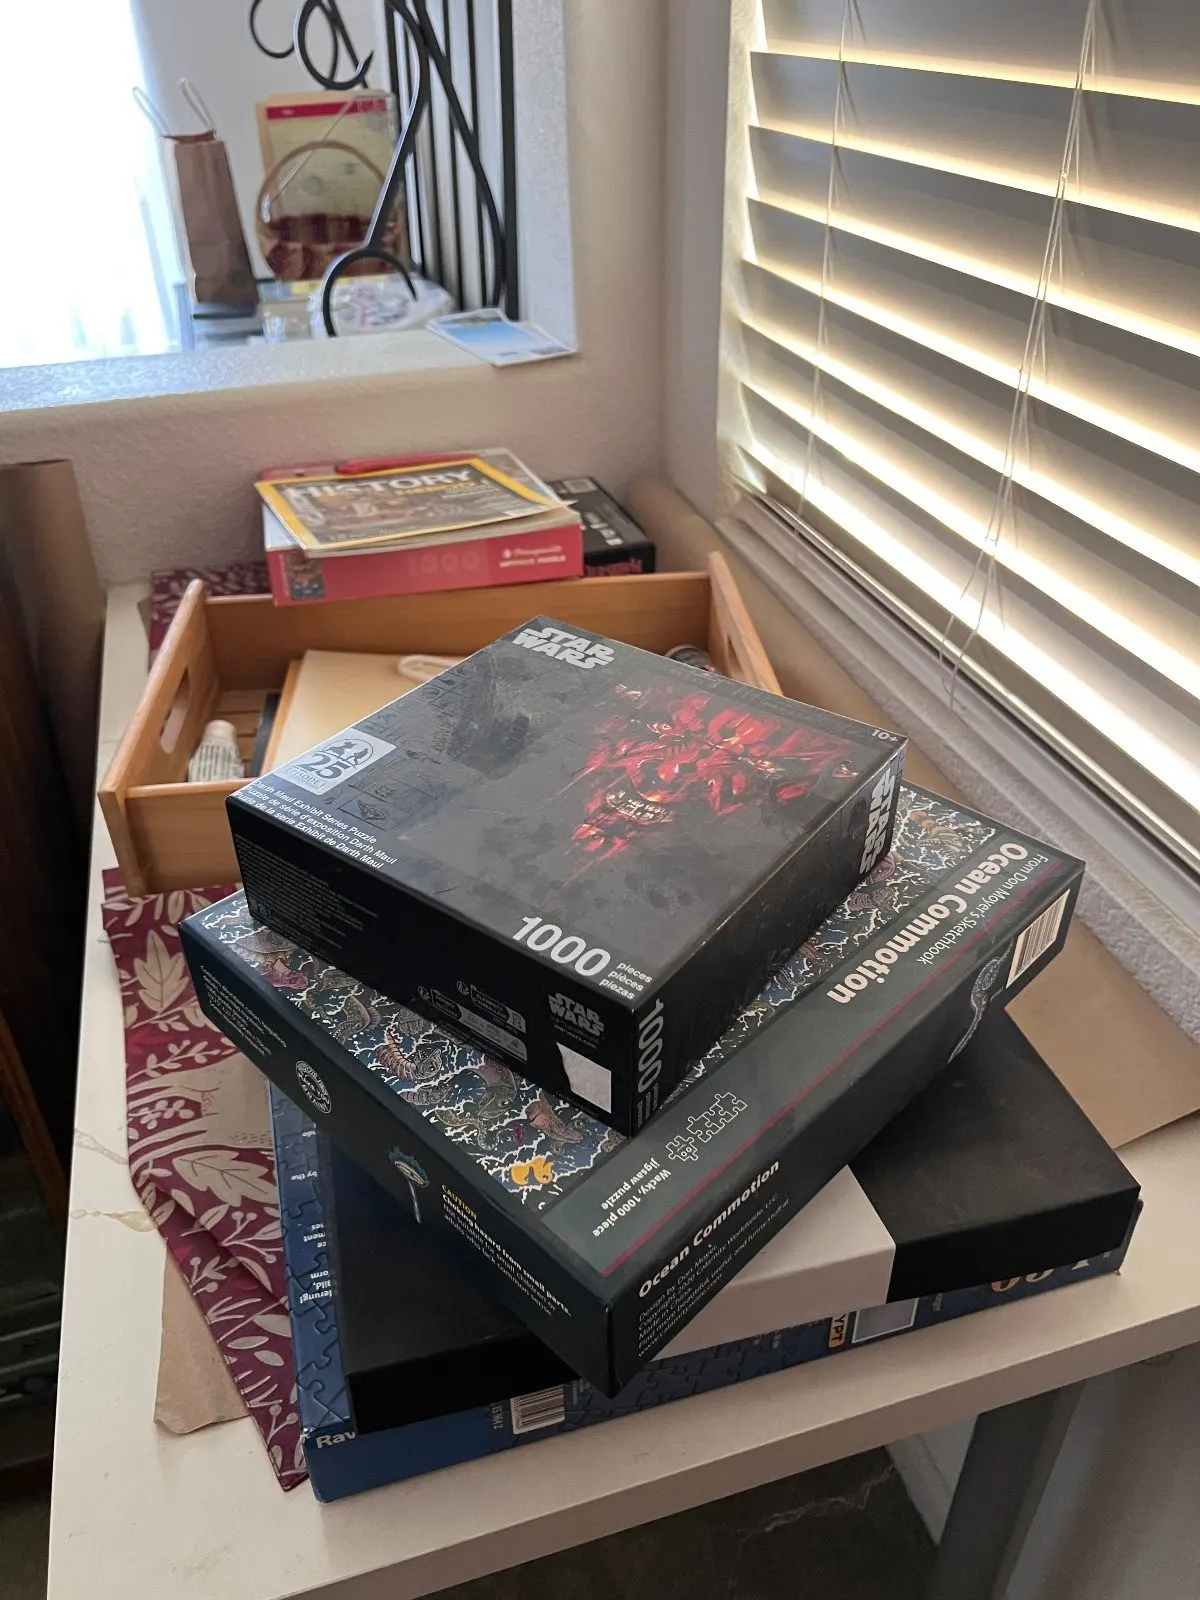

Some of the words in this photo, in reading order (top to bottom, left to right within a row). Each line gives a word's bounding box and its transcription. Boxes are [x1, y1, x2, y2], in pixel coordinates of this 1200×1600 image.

[512, 632, 610, 669] WARS
[522, 627, 615, 662] STAR
[869, 728, 899, 743] 10+
[294, 752, 352, 780] 25
[246, 786, 269, 801] Puzzle
[268, 798, 280, 806] de
[299, 813, 350, 842] d'exposition
[349, 838, 374, 853] Darth
[373, 849, 398, 865] Maul
[252, 779, 275, 793] Darth
[273, 790, 296, 803] Maul
[293, 799, 324, 817] Exhibit
[321, 813, 349, 830] Series
[347, 826, 377, 844] Puzzle
[859, 773, 886, 874] WARS
[865, 767, 896, 873] STAR
[254, 802, 267, 810] de
[265, 807, 276, 815] la
[274, 812, 296, 825] serie
[295, 822, 326, 840] Exhibit
[323, 837, 337, 846] de
[335, 842, 361, 858] Darth
[359, 854, 384, 869] Maul
[953, 843, 1028, 895] Ocean
[1020, 853, 1049, 873] From
[1002, 872, 1028, 890] Don
[969, 887, 1010, 918] Moyer's
[511, 916, 611, 977] 1000
[826, 894, 968, 1004] Commotion
[917, 916, 977, 965] Sketchbook
[607, 968, 644, 993] pièces
[616, 960, 653, 984] pieces
[598, 977, 635, 1001] piezas
[548, 992, 604, 1028] STAR
[548, 1003, 604, 1036] WARS
[637, 997, 664, 1093] 1000
[291, 1172, 306, 1181] the
[630, 1157, 660, 1186] jigsaw
[637, 1169, 672, 1195] Wacky,
[441, 1184, 477, 1220] CAUTION
[601, 1181, 632, 1210] puzzle
[616, 1195, 641, 1217] 1000
[592, 1212, 619, 1237] piece
[638, 1246, 690, 1298] Ocean
[693, 1161, 779, 1247] Commotion
[442, 1194, 474, 1227] Choking
[474, 1222, 501, 1252] hazard
[502, 1248, 522, 1271] from
[523, 1269, 545, 1292] small
[309, 1270, 329, 1279] orm
[496, 1253, 515, 1273] small
[496, 1263, 530, 1296] common
[638, 1292, 676, 1331] Copyright
[677, 1274, 696, 1295] 2020
[696, 1244, 726, 1275] Calamity
[639, 1294, 666, 1322] Design
[666, 1284, 676, 1297] by
[677, 1267, 693, 1285] Don
[638, 1317, 661, 1340] Made
[661, 1309, 669, 1319] in
[656, 1311, 676, 1332] more
[315, 1430, 356, 1449] Rav
